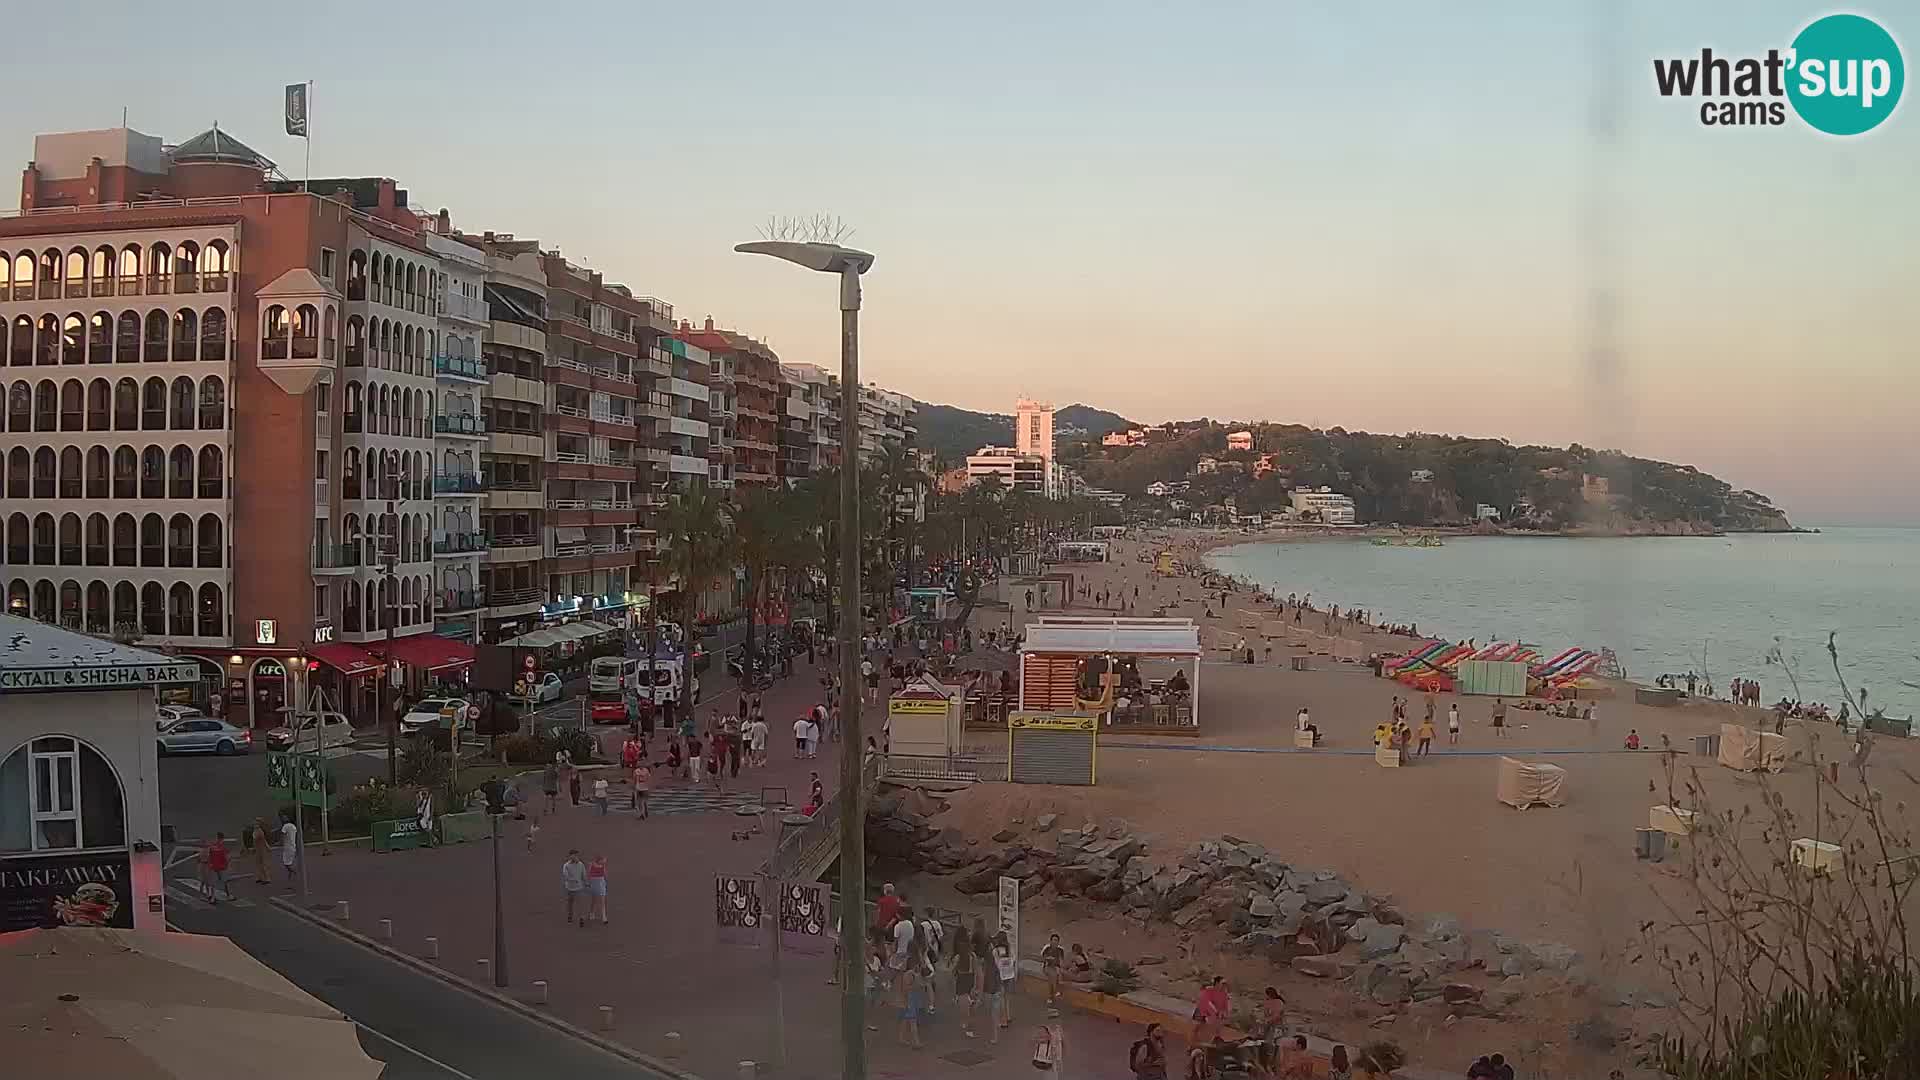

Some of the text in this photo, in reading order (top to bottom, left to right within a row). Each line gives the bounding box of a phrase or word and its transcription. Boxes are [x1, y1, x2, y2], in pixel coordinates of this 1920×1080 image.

[314, 625, 334, 643] KFC
[0, 667, 180, 687] CKTAIL & SHISHA BAR
[259, 664, 281, 675] KFC
[0, 864, 121, 888] TAKEAWAY
